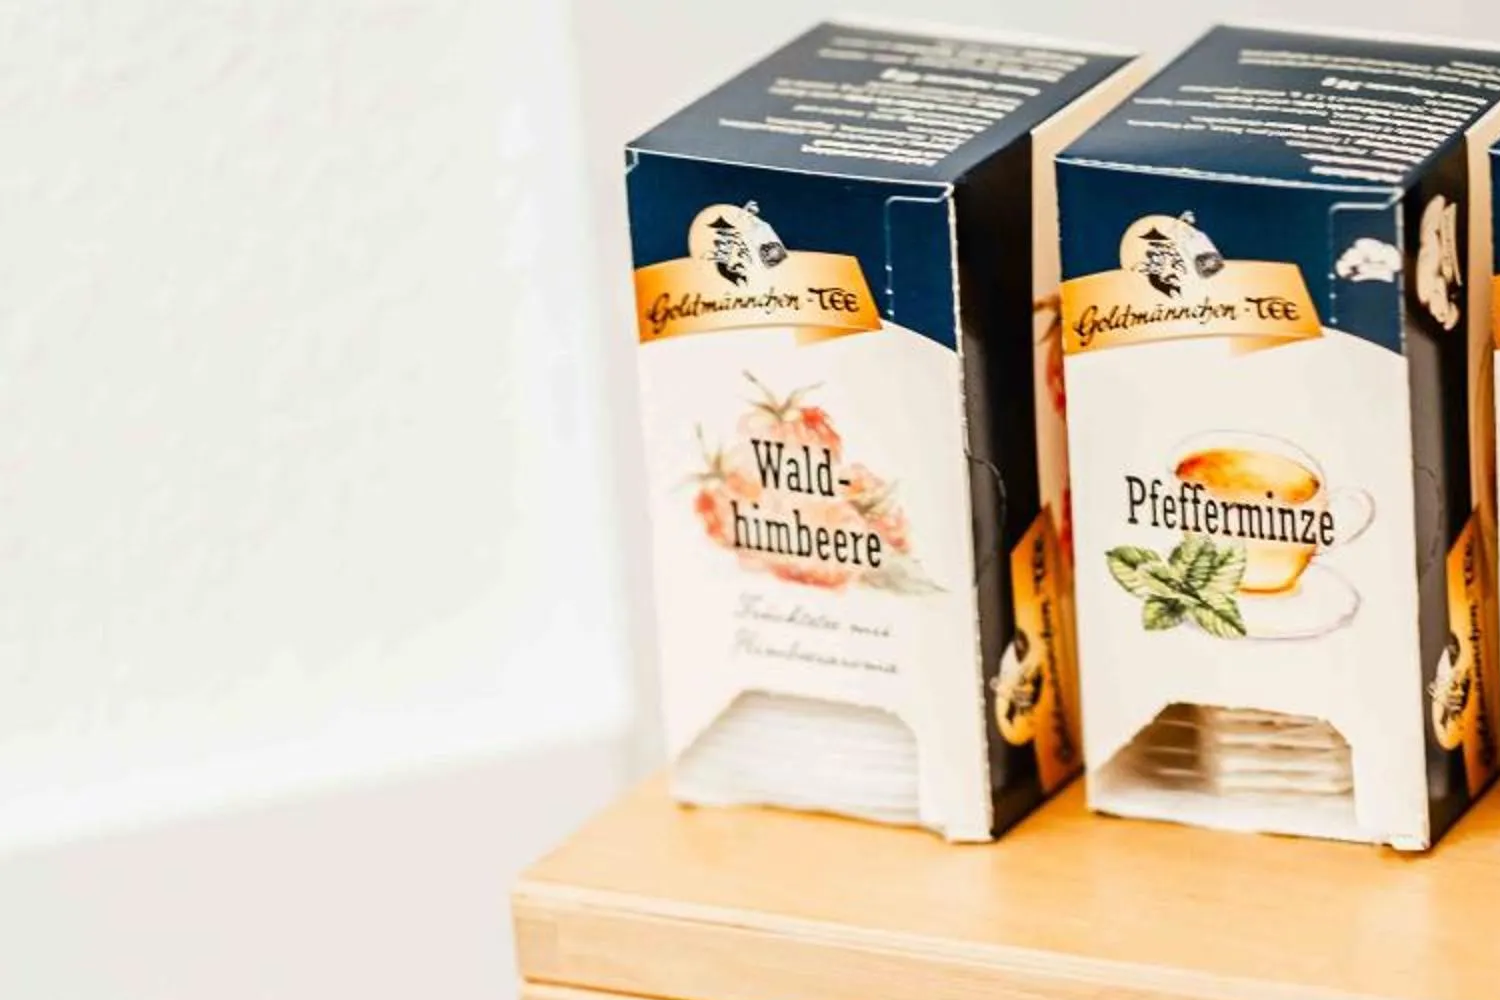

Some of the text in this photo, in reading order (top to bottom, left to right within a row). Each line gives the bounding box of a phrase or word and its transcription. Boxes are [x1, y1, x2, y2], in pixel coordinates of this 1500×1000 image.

[750, 438, 852, 498] Wald-
[730, 500, 882, 569] himbeere
[1124, 475, 1336, 547] Pfefferminze
